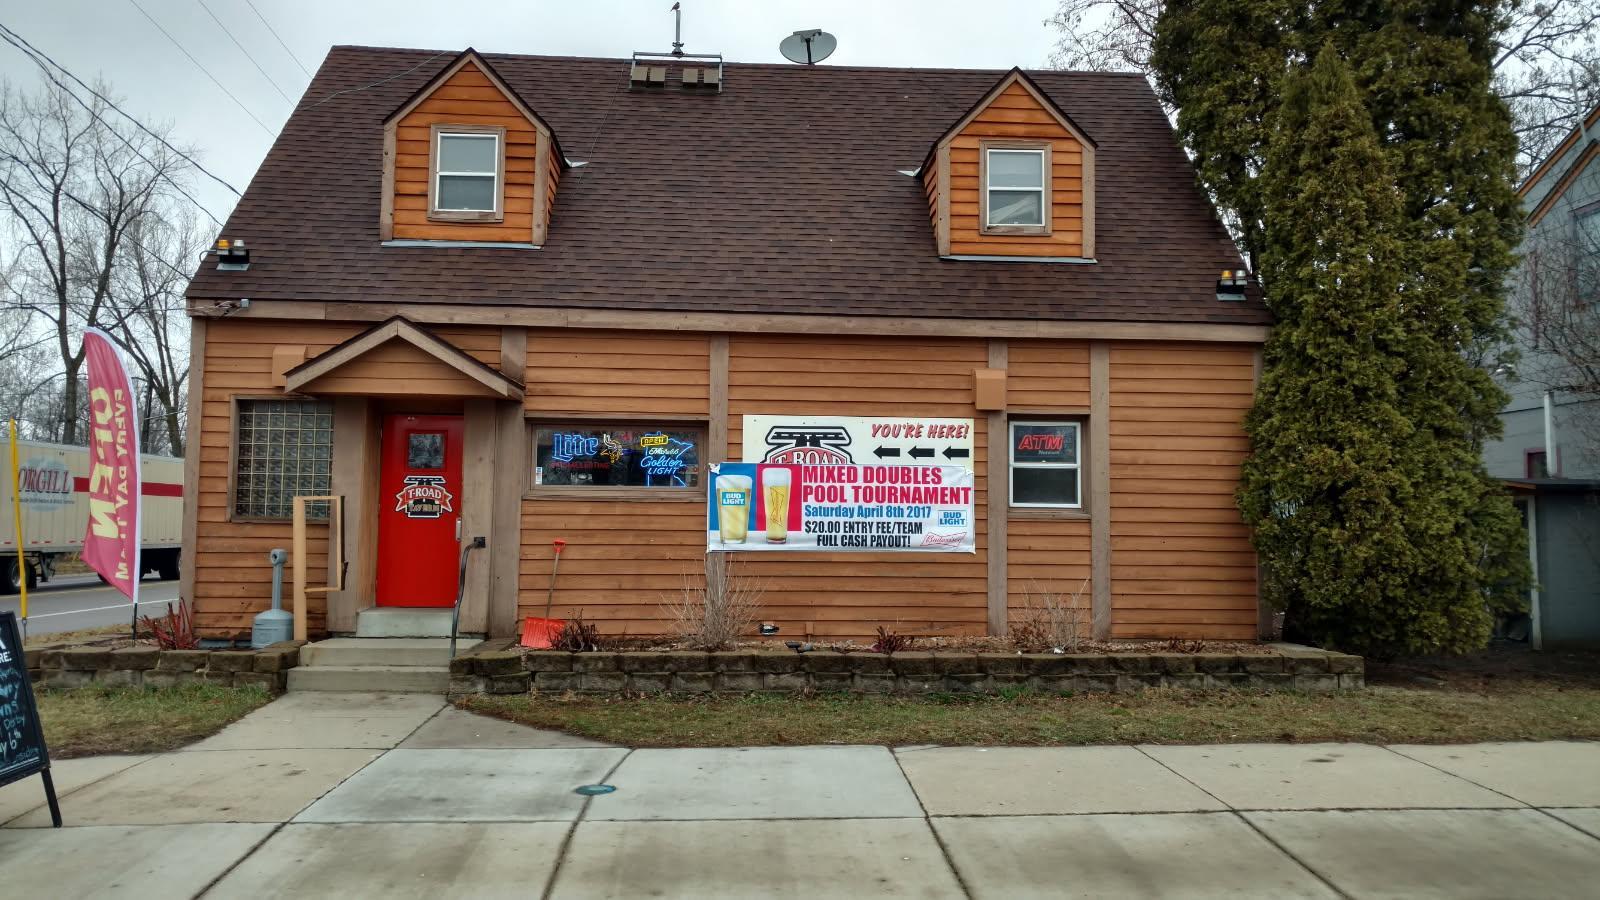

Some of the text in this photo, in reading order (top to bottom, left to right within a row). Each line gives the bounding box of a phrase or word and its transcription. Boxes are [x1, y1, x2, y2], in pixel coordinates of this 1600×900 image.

[871, 423, 970, 439] YOU'RE HERE!
[552, 433, 599, 461] Lite
[1018, 434, 1065, 450] ATM
[641, 455, 686, 467] Golden
[648, 467, 679, 475] LIGHT
[802, 465, 942, 485] MIXED DOUBLES
[17, 467, 70, 493] ORGILL
[407, 487, 442, 499] T-ROAD
[802, 485, 971, 505] POOL TOURNAMENT
[804, 505, 931, 519] Saturday April 8th 2017
[943, 511, 962, 519] BUD
[805, 520, 923, 534] $20.00 ENTRY FEE/TEAM
[816, 534, 911, 547] FULL CASH PAYOUT!
